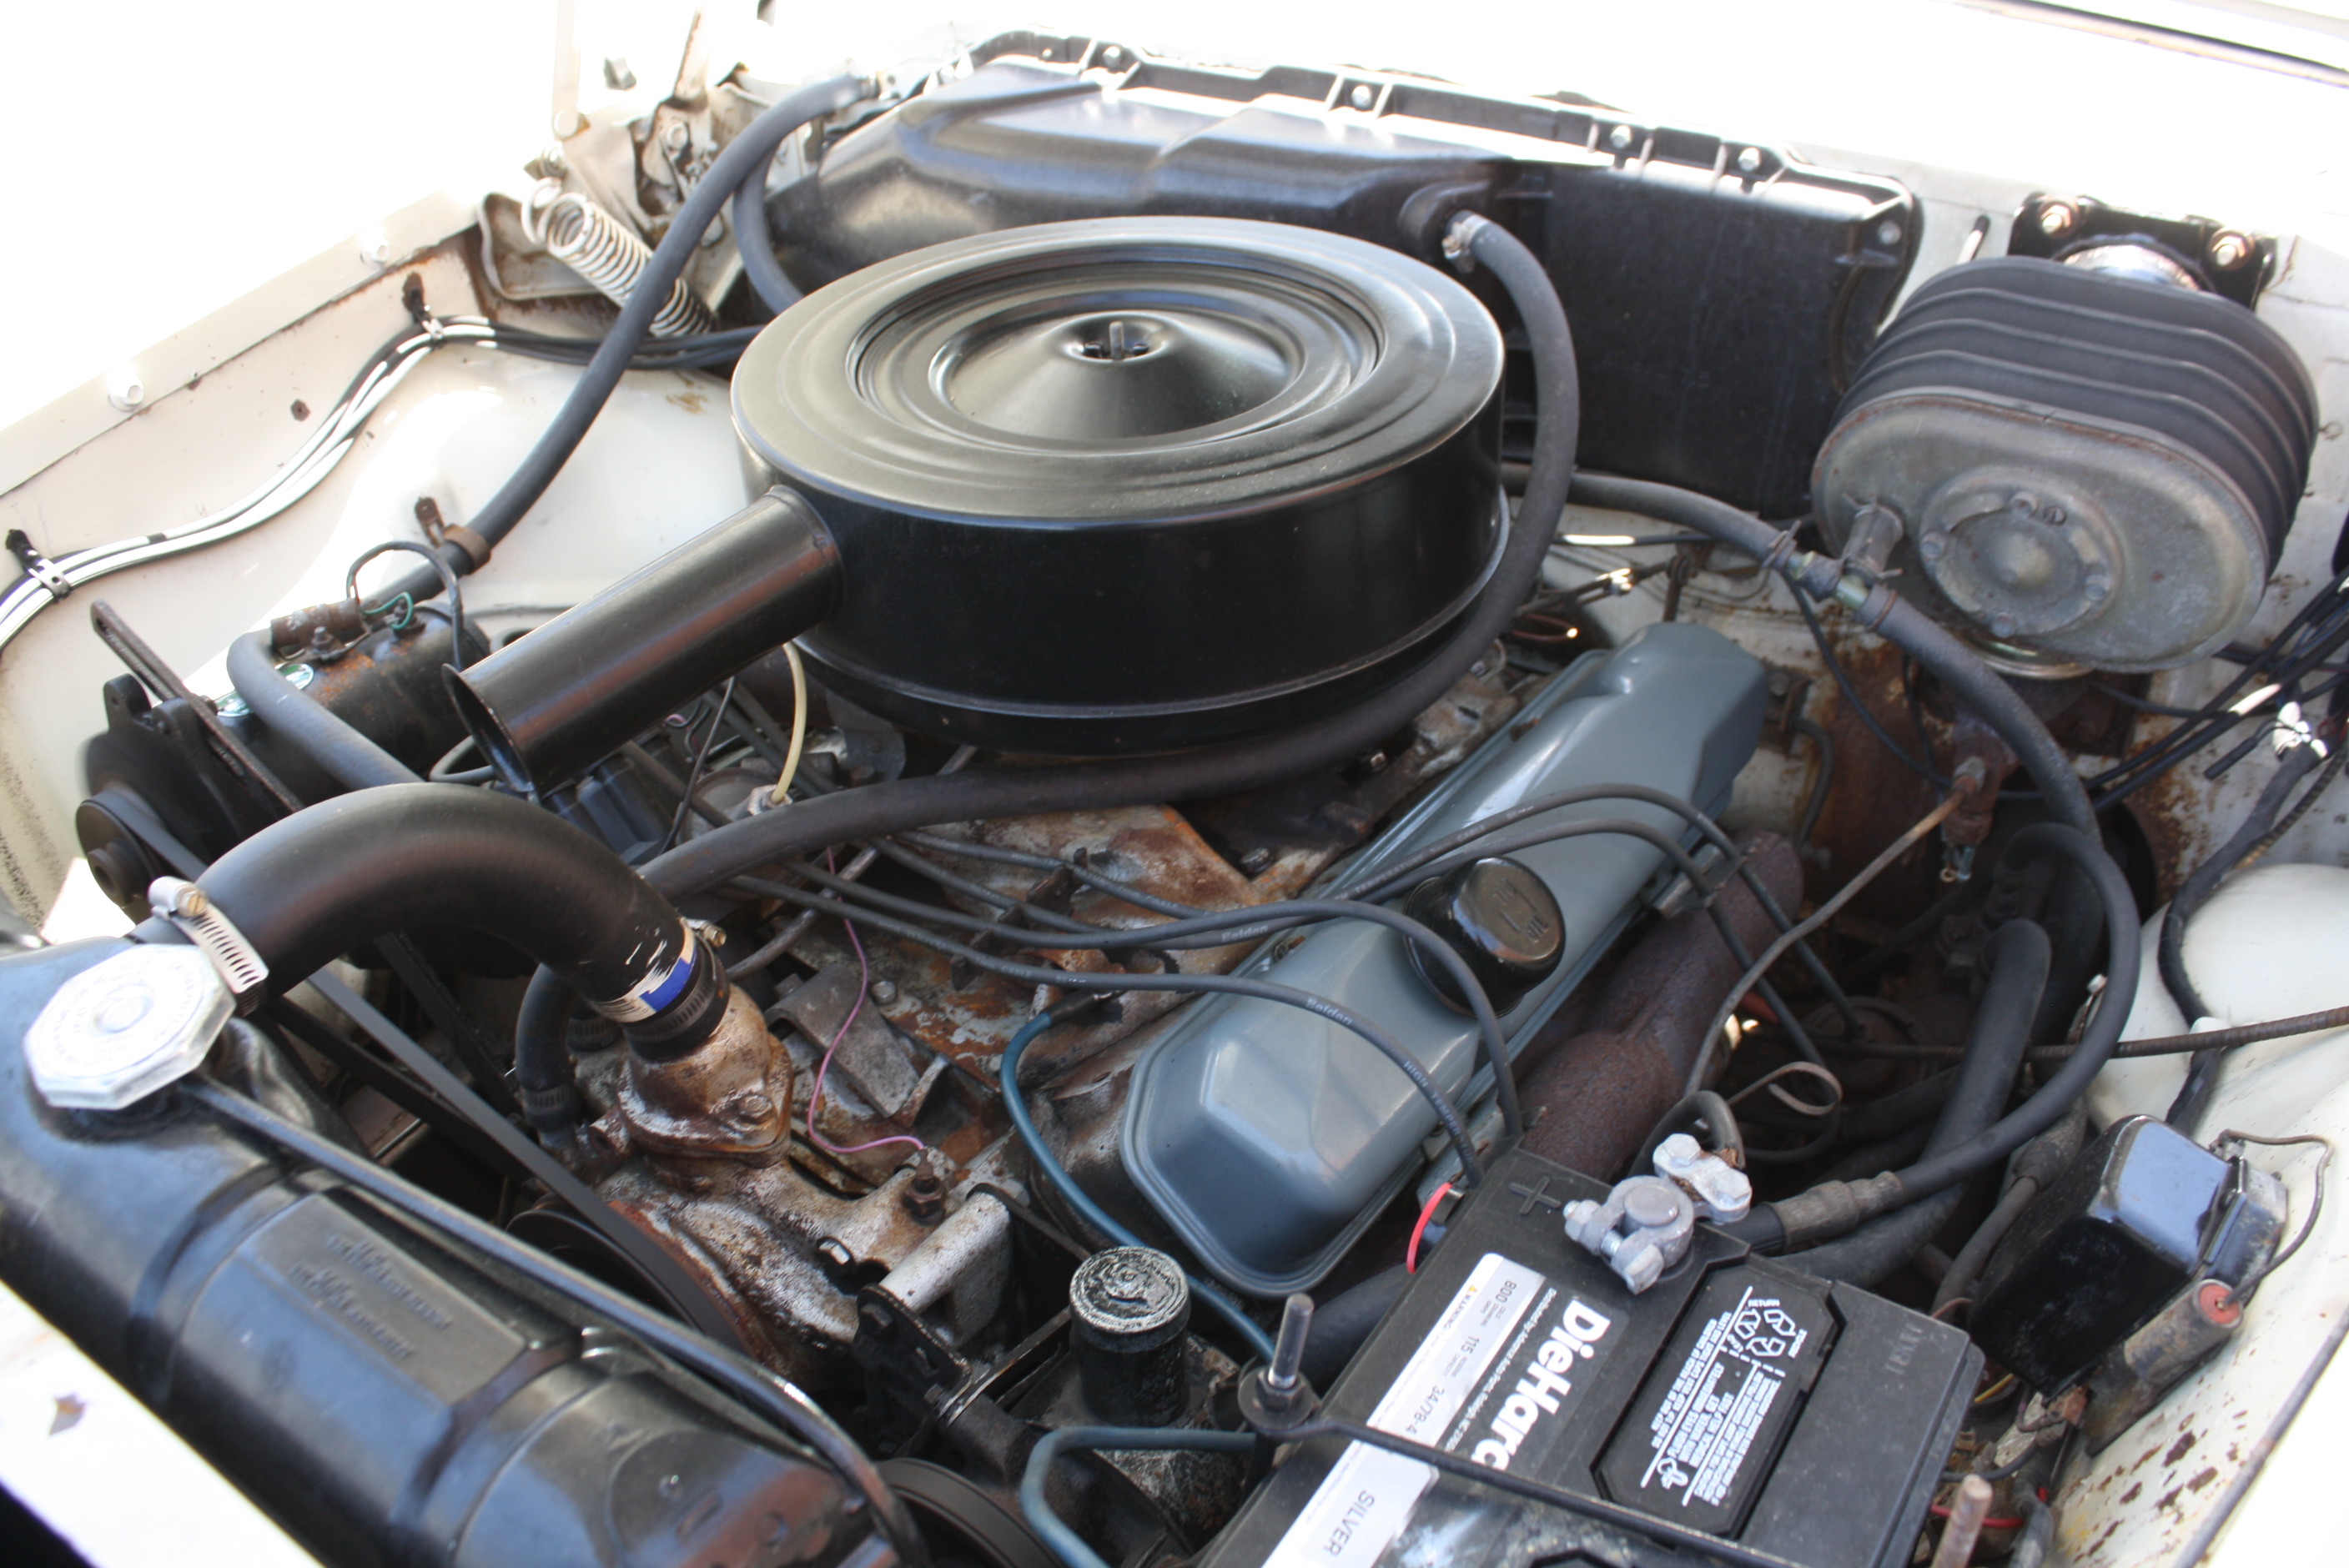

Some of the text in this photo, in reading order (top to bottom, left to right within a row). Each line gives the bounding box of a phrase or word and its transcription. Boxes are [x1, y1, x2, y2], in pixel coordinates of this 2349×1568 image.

[1221, 924, 1269, 942] Belden
[1305, 998, 1353, 1026] Belden
[1403, 1060, 1429, 1088] HIGH
[1494, 1279, 1517, 1304] 800
[1748, 1299, 1779, 1308] RETURN
[1459, 1333, 1481, 1355] 115
[1406, 1385, 1445, 1435] 34/78-4
[1324, 1490, 1376, 1556] SILVER
